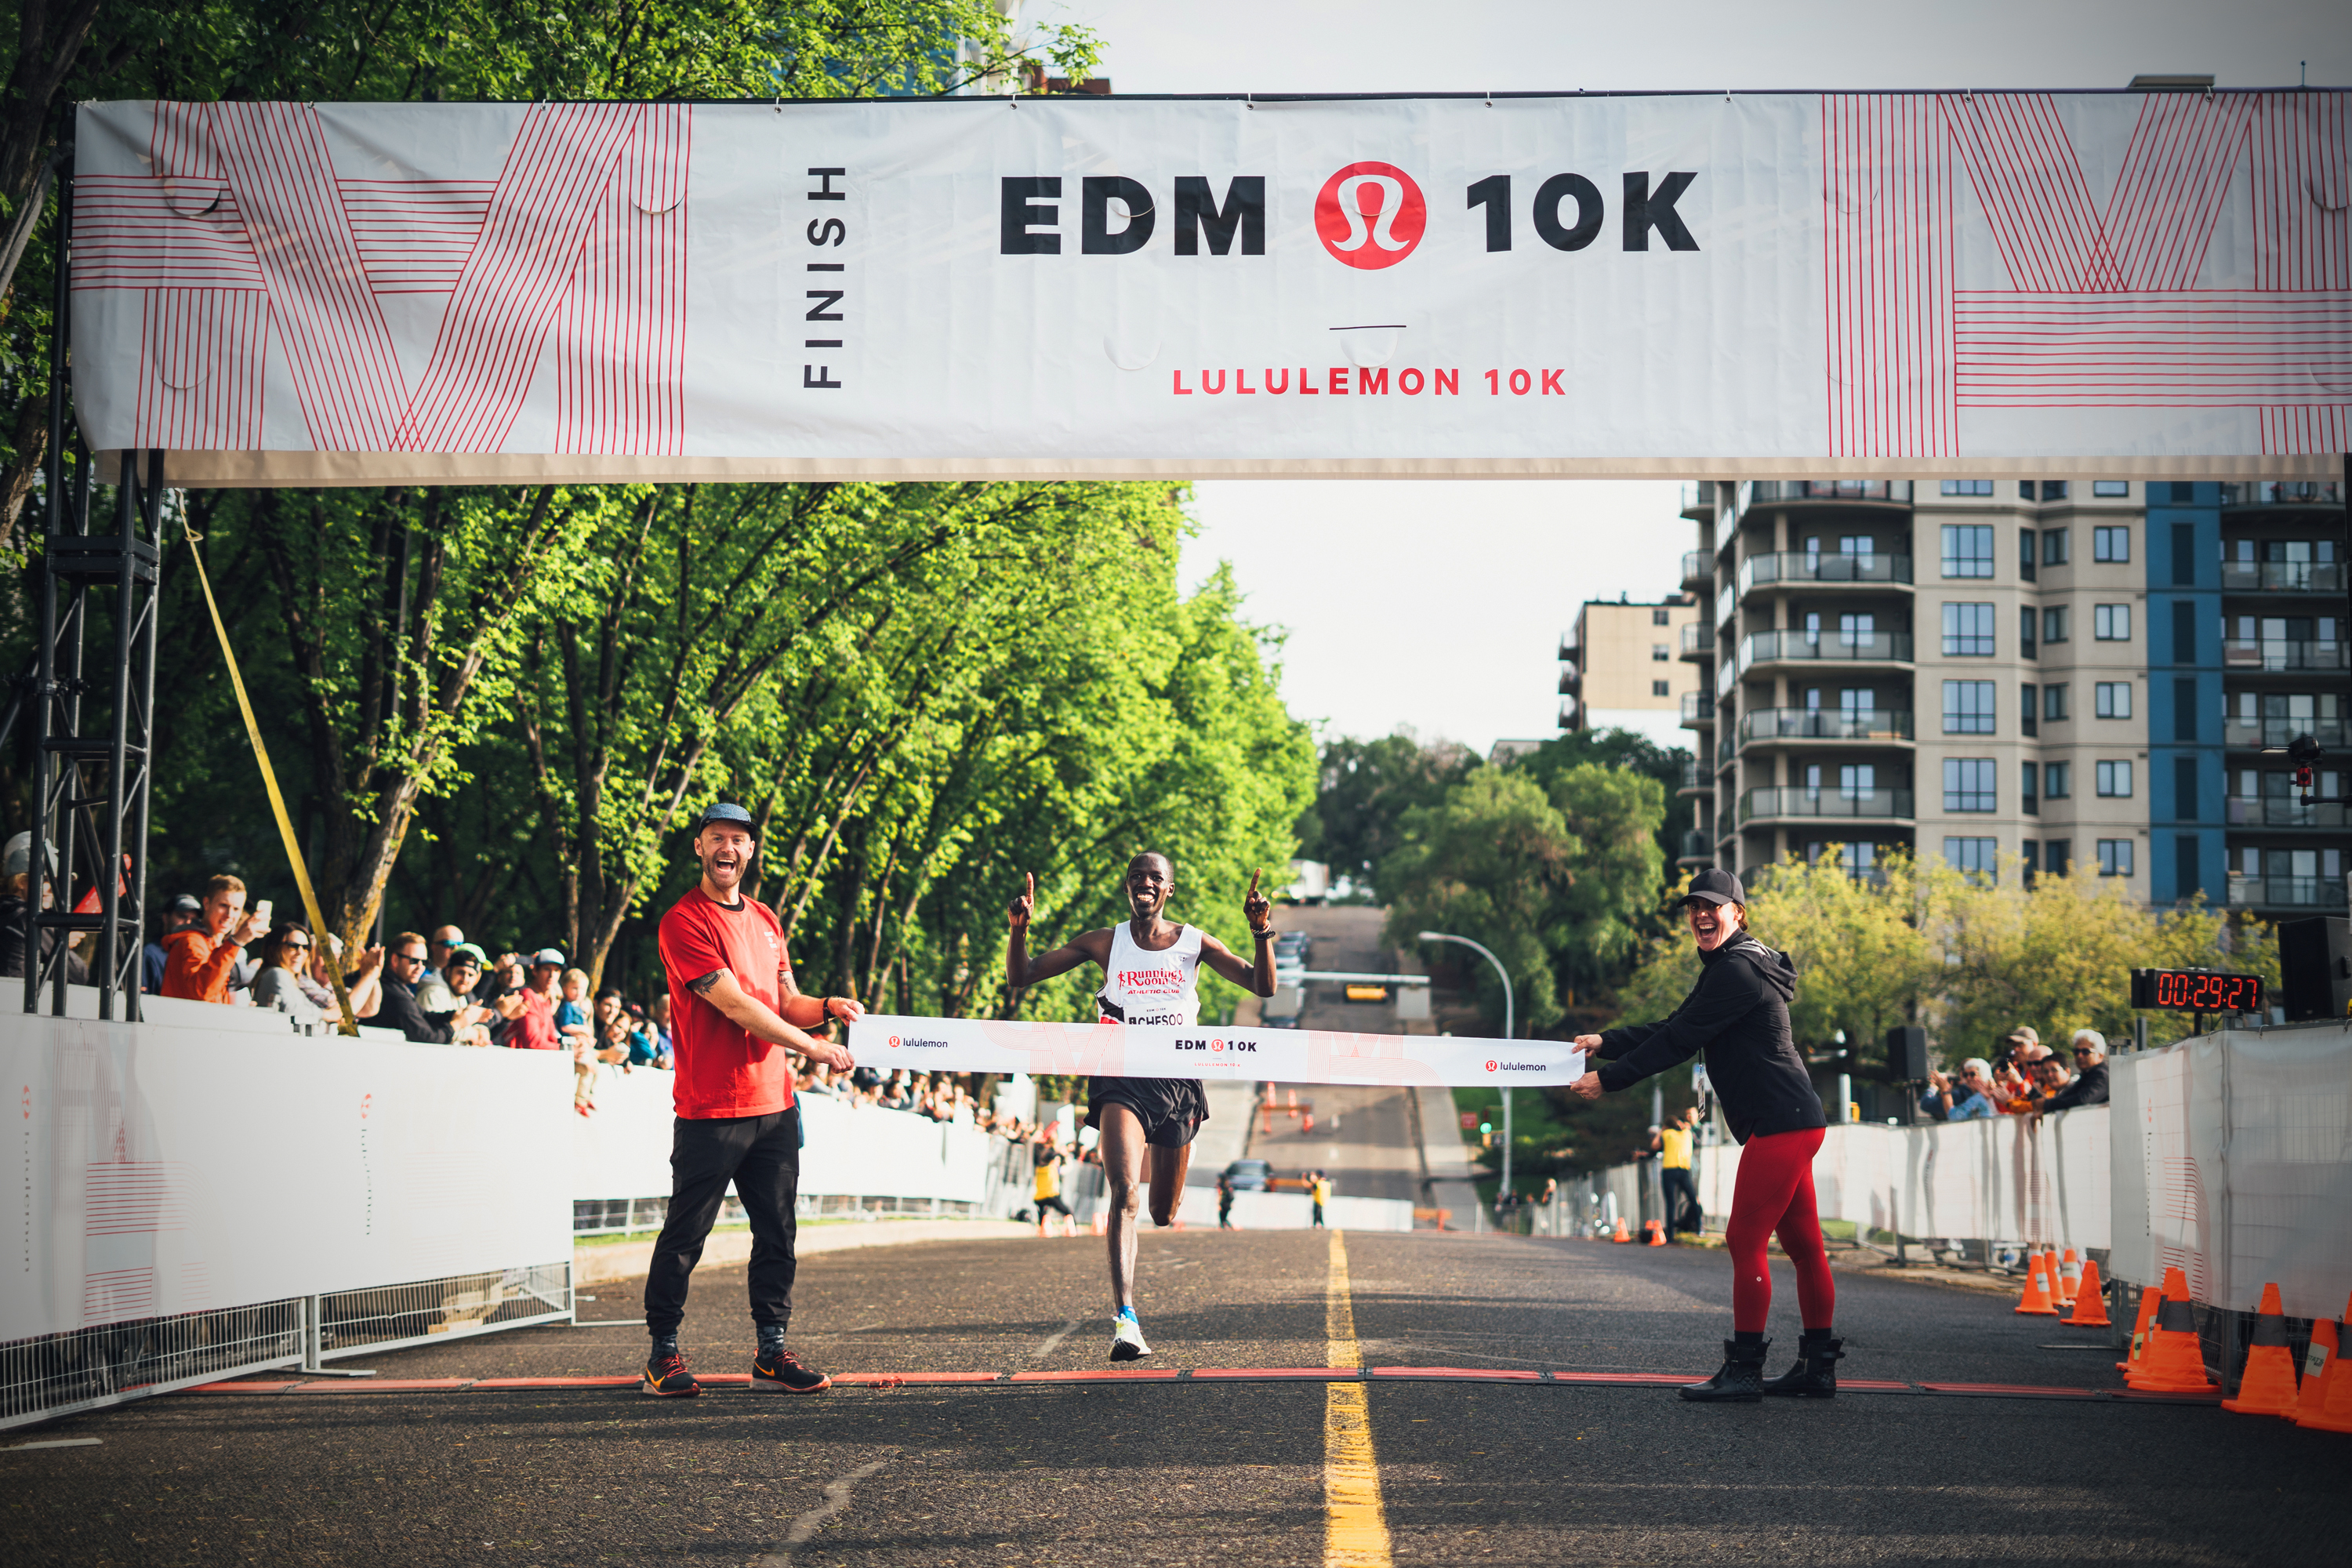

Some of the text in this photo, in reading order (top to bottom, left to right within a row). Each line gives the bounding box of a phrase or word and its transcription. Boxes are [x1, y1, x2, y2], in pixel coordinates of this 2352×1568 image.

[1000, 170, 1701, 256] EDM 10K
[803, 166, 846, 389] FINISH
[1173, 367, 1566, 396] LULULEMON 10K
[1126, 967, 1178, 986] Running
[2158, 973, 2258, 1009] 00:29:27
[902, 1037, 949, 1048] lululemon
[1175, 1040, 1258, 1052] EDM 10K
[1500, 1062, 1547, 1072] lululemon
